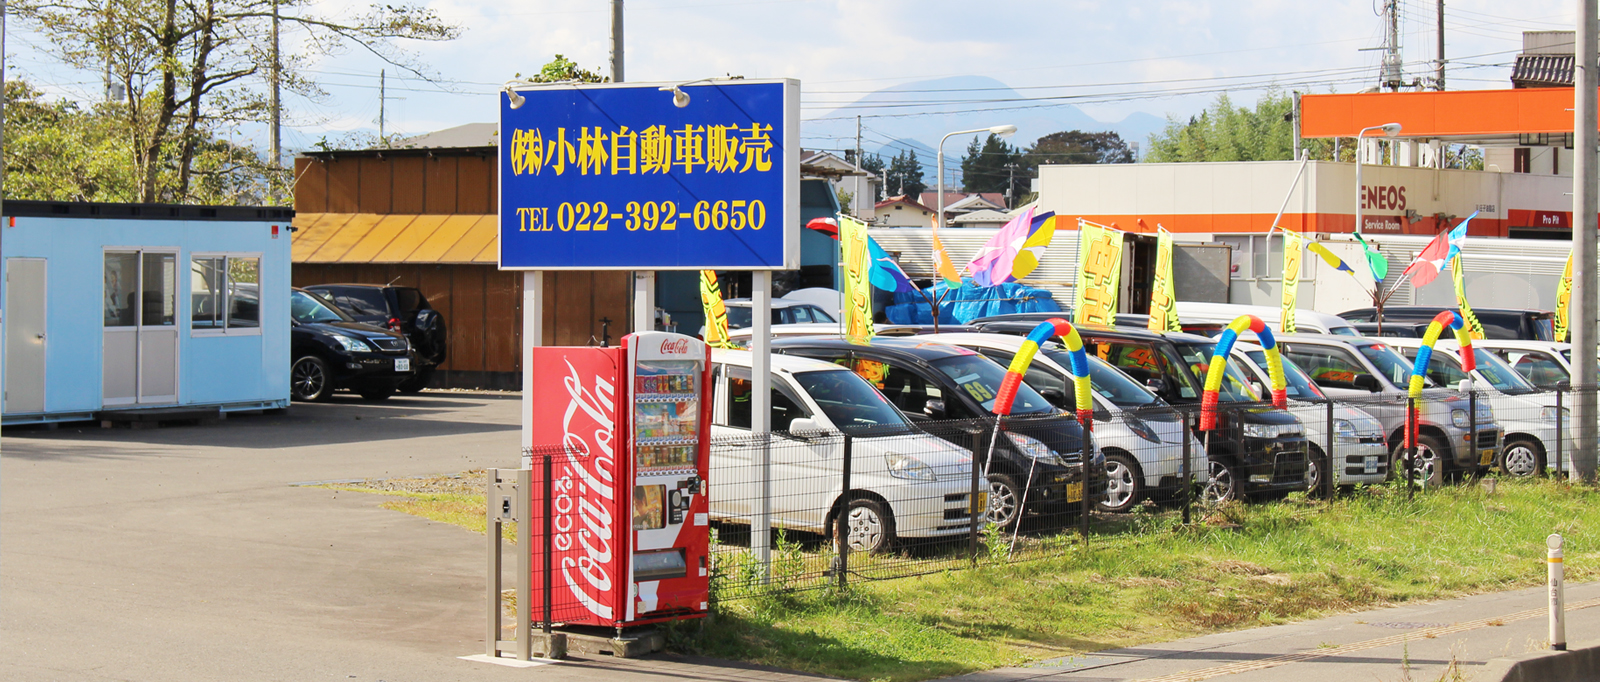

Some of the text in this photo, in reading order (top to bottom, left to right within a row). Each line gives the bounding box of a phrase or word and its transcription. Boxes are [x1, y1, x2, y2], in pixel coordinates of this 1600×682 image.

[516, 199, 766, 232] TEL 022-392-6650
[1542, 215, 1553, 225] Pro
[1364, 219, 1401, 231] Service Room
[964, 381, 993, 402] 69
